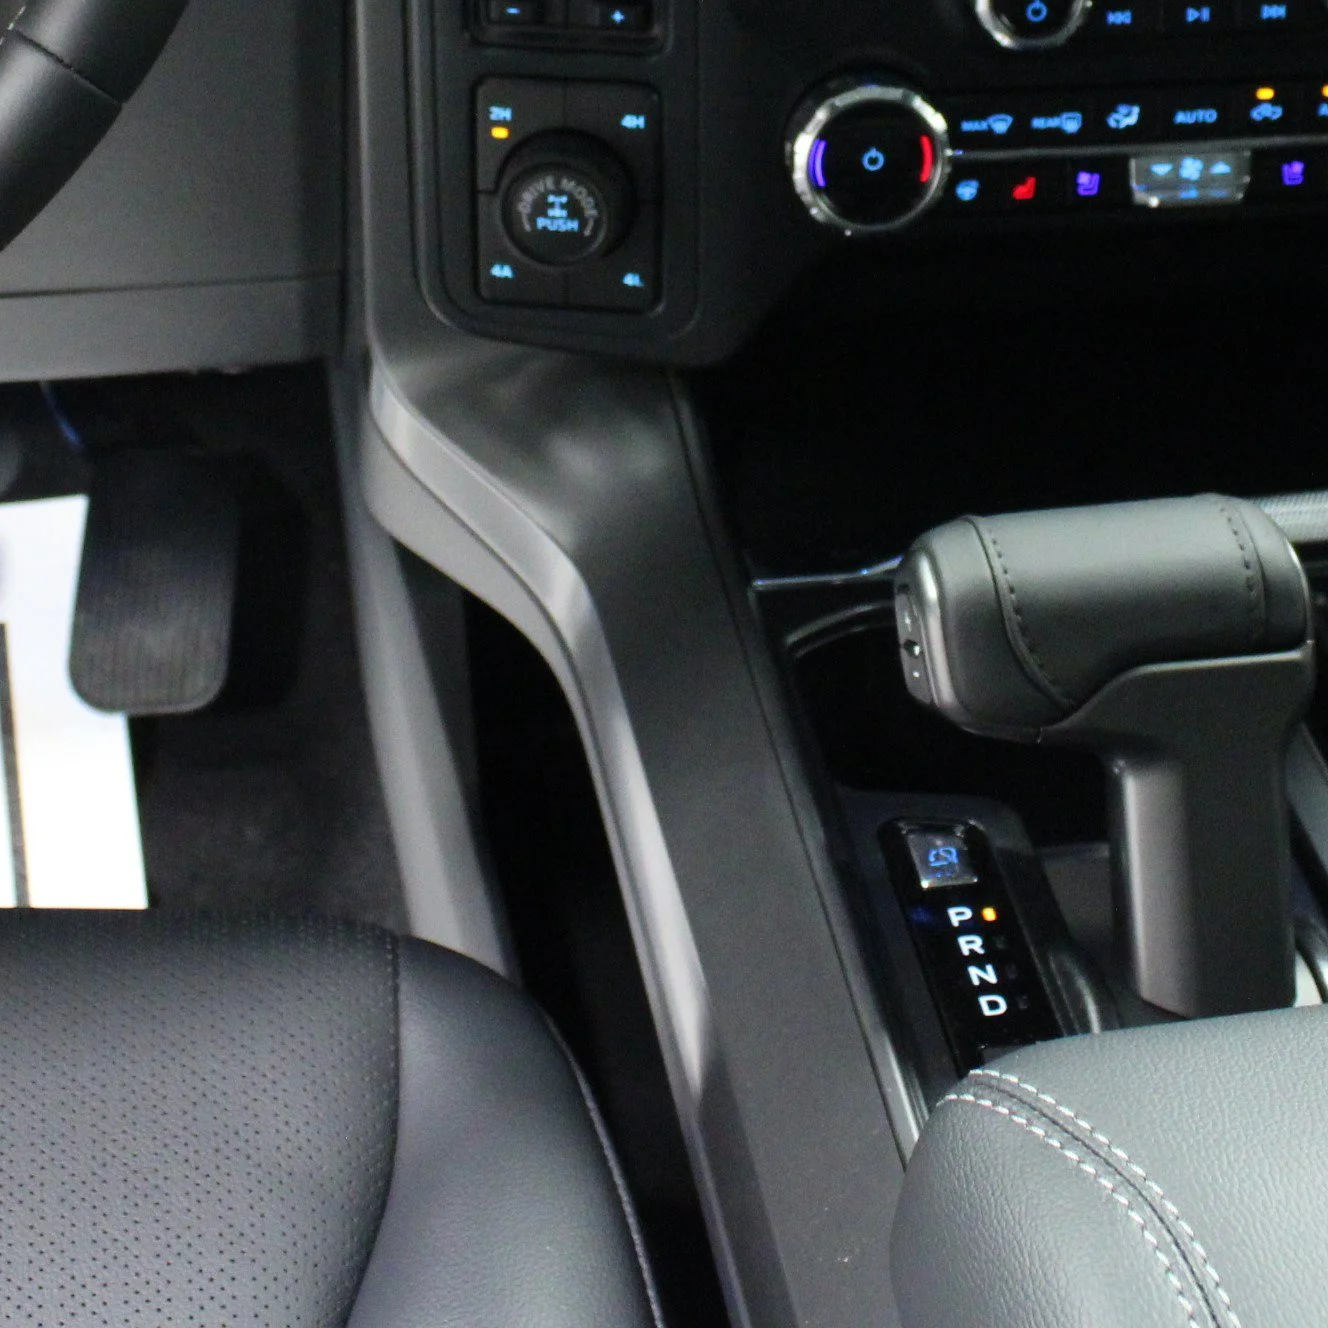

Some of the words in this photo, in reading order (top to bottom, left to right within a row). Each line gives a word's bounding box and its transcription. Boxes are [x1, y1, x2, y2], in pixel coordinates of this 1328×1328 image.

[489, 106, 513, 122] 2H
[1174, 108, 1217, 125] AUTO
[536, 216, 580, 232] PUSH
[947, 906, 972, 928] P
[957, 934, 985, 956] R
[967, 964, 998, 987] N
[978, 994, 1008, 1017] D
